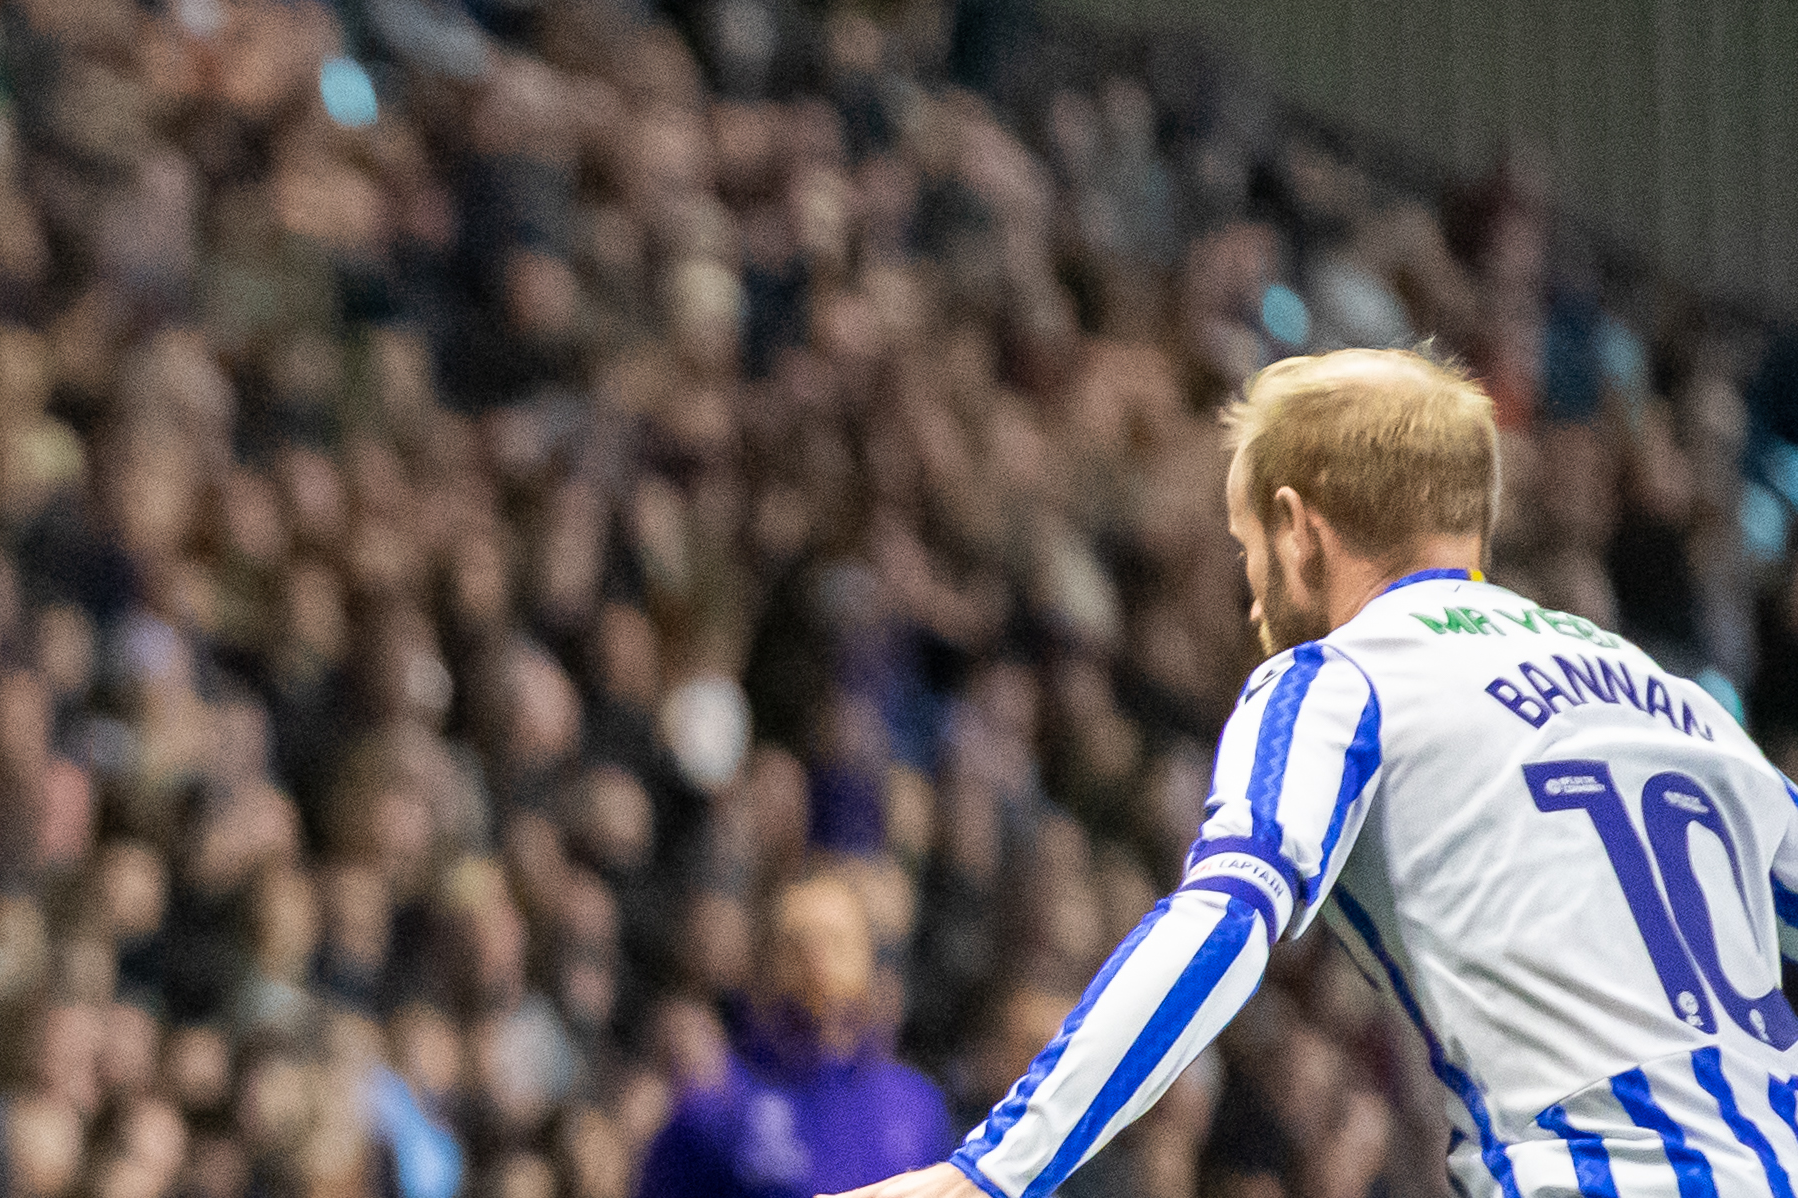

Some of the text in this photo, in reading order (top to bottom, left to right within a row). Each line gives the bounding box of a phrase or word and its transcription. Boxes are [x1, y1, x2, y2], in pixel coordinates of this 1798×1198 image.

[1408, 605, 1506, 636] MR
[1485, 653, 1714, 742] BANNAN
[1219, 858, 1285, 899] CAPTAIN
[1521, 758, 1798, 1052] 10
